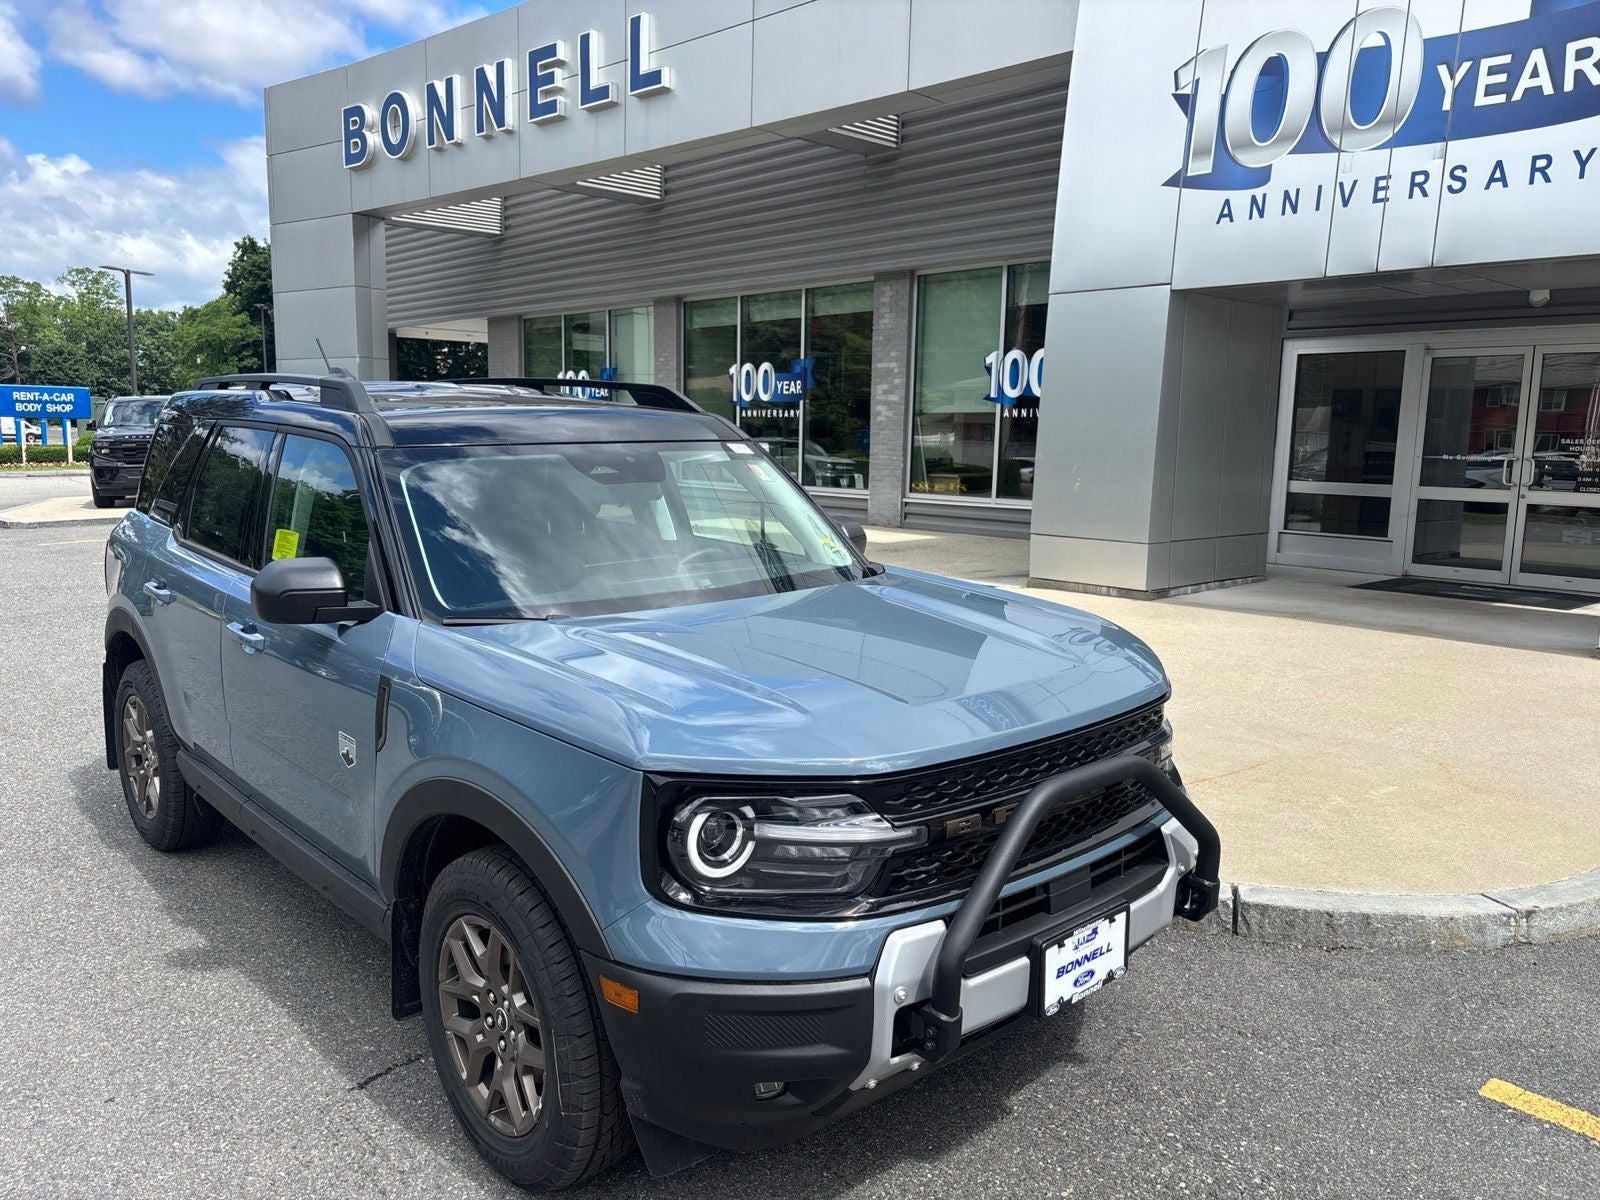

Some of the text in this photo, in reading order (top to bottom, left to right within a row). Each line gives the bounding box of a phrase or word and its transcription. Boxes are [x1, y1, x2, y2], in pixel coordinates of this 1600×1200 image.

[341, 11, 673, 170] BONNELL
[1174, 6, 1600, 176] 100 YEAR
[1215, 147, 1599, 225] ANNIVERSARY
[12, 391, 75, 402] RENT-A-CAR
[728, 361, 803, 402] 100 YEAR
[15, 402, 74, 413] BODY SHOP
[741, 409, 800, 418] ANNIVERSARY
[1055, 942, 1113, 979] BONNELL
[1071, 979, 1104, 1004] Bonnell
